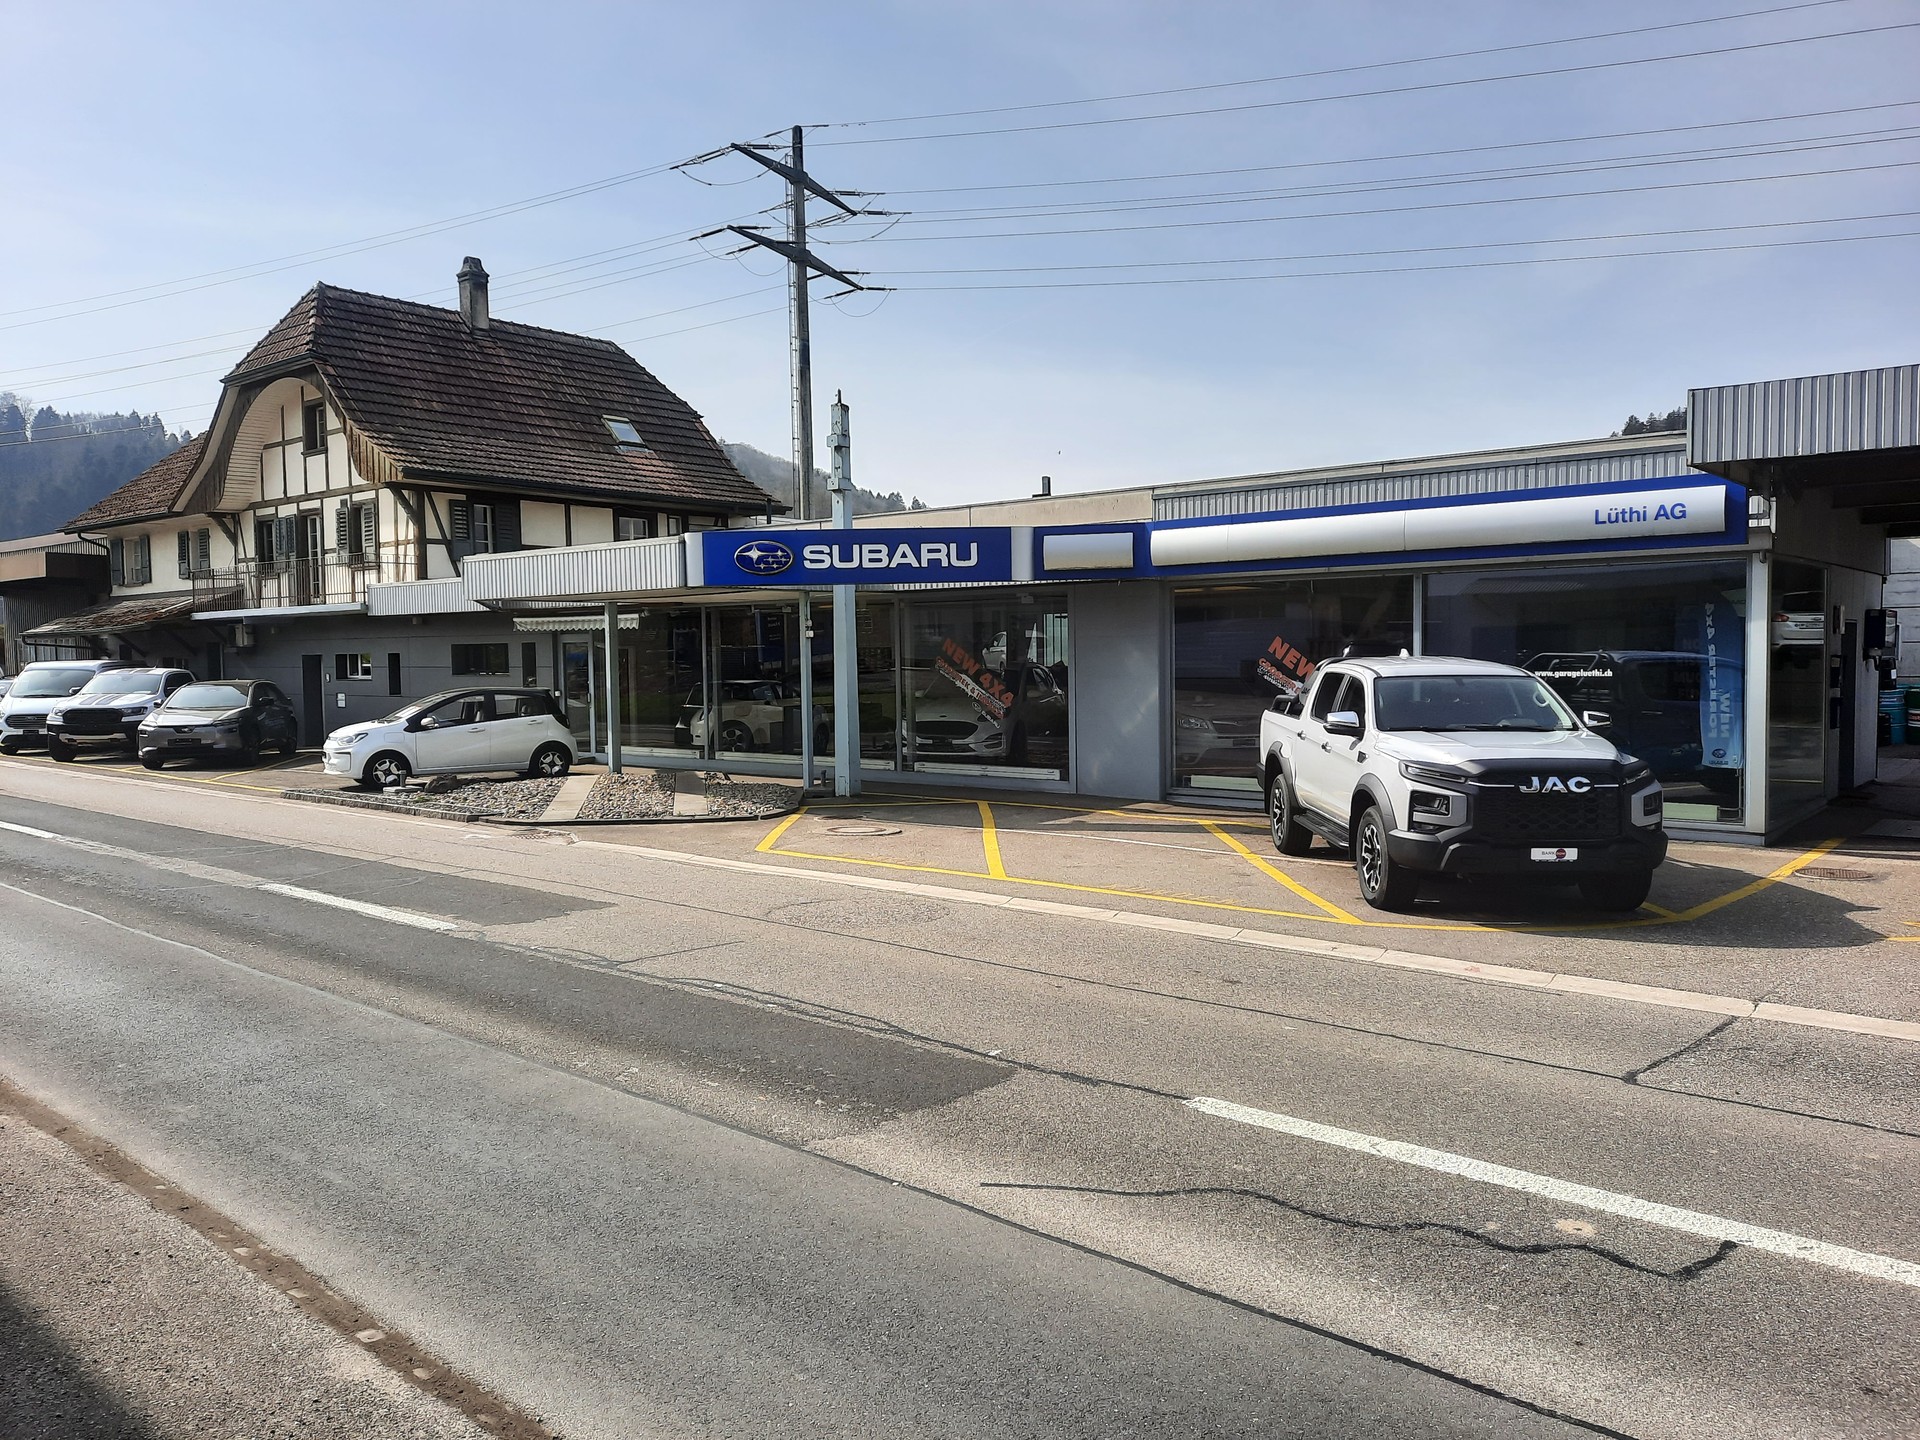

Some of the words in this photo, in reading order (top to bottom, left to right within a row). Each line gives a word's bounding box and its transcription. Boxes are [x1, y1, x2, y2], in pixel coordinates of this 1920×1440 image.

[1594, 506, 1647, 525] Lüthi
[1654, 503, 1686, 521] AG
[803, 542, 978, 569] SUBARU
[1267, 635, 1316, 682] NEW
[942, 638, 981, 676] NEW
[979, 672, 1014, 708] 4X4
[1534, 668, 1613, 678] www.garageluethi.ch
[981, 710, 1000, 729] SUBARU
[1519, 776, 1591, 793] JAC
